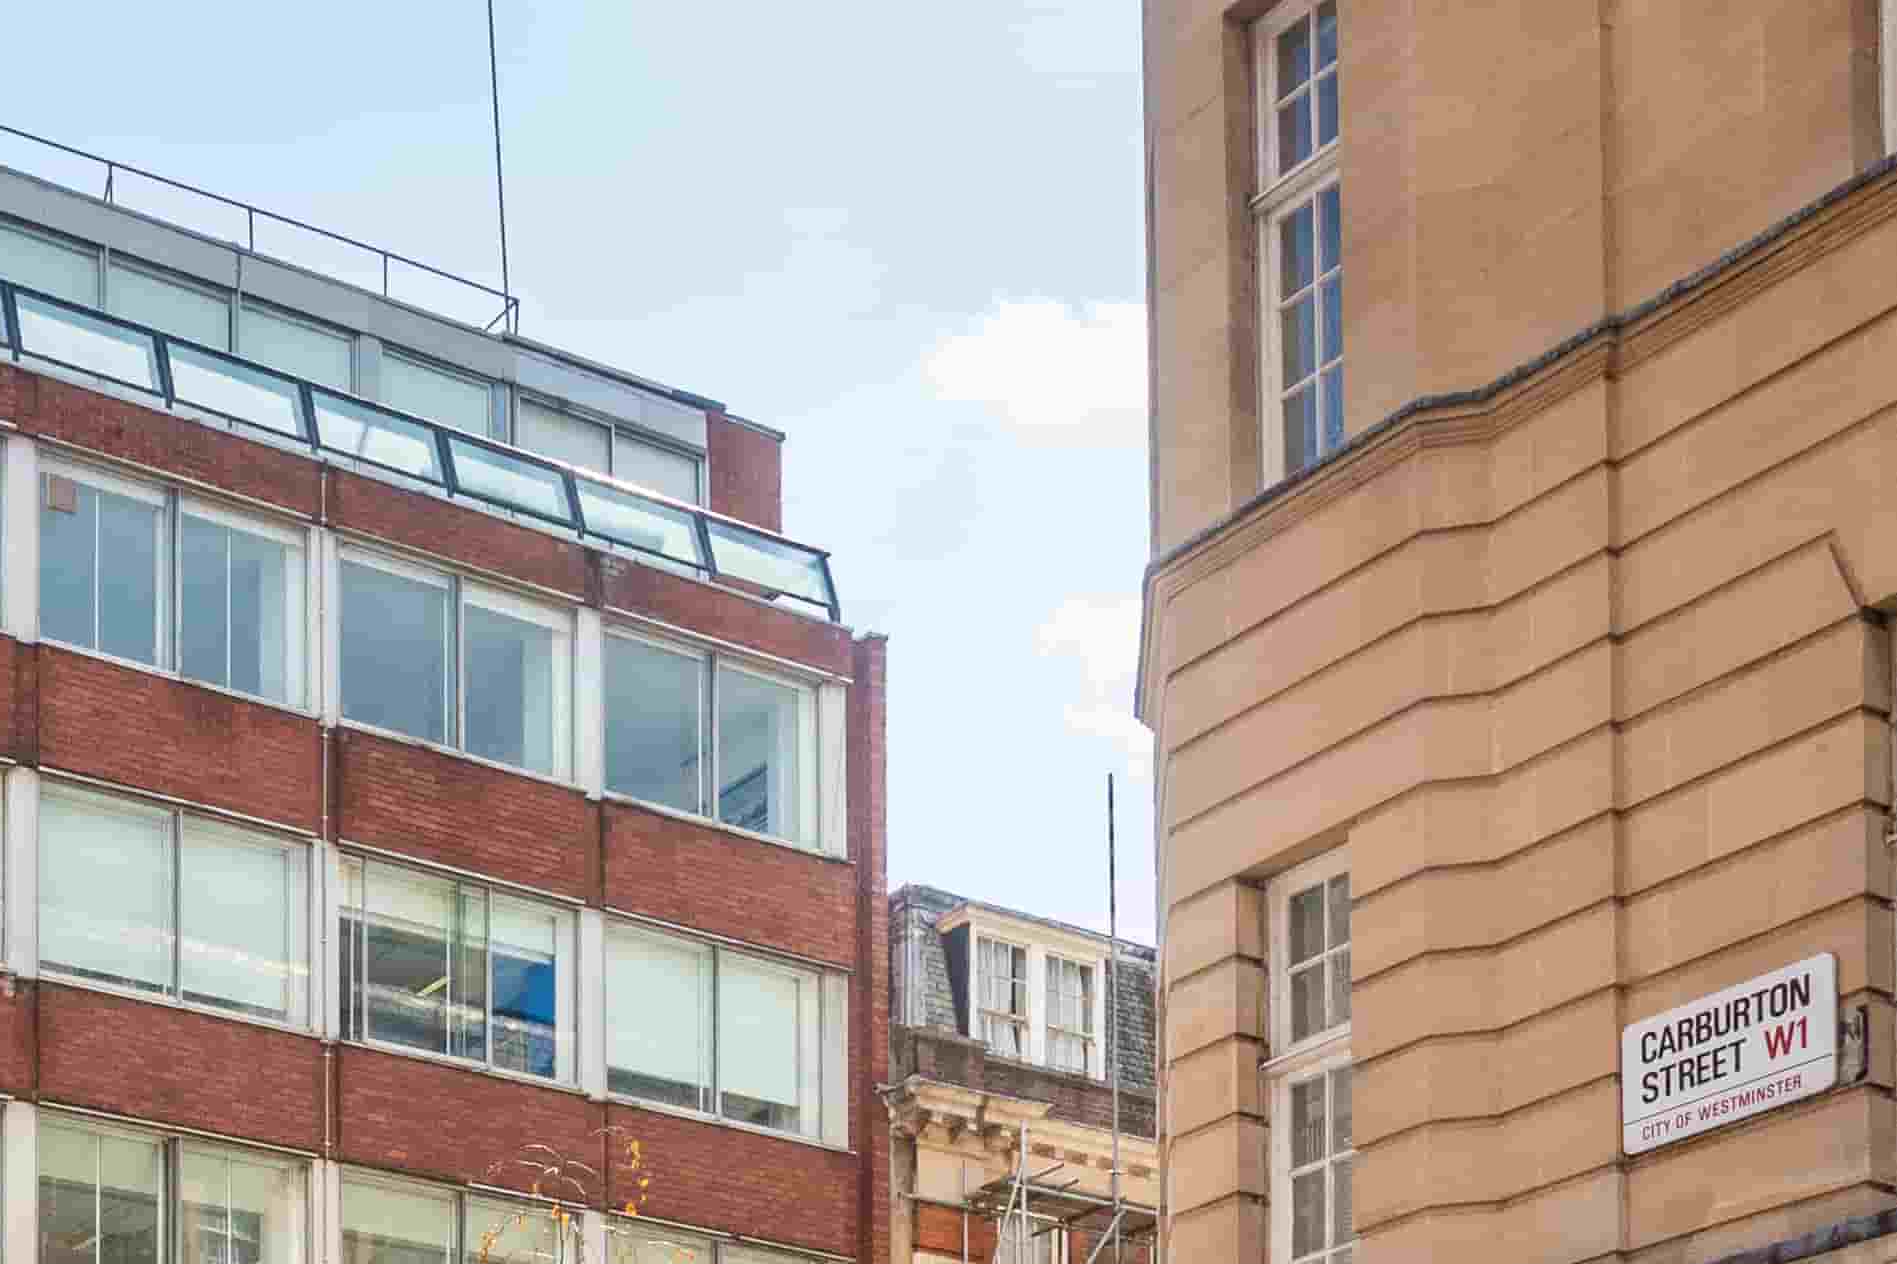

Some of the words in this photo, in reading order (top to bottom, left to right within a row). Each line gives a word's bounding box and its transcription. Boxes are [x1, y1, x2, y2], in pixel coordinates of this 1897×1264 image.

[1640, 973, 1811, 1064] CARBURTON
[1640, 1039, 1747, 1104] STREET
[1764, 1015, 1809, 1060] W1
[1641, 1120, 1672, 1141] CITY
[1675, 1113, 1692, 1130] OF
[1696, 1073, 1803, 1121] WESTMINSTER
